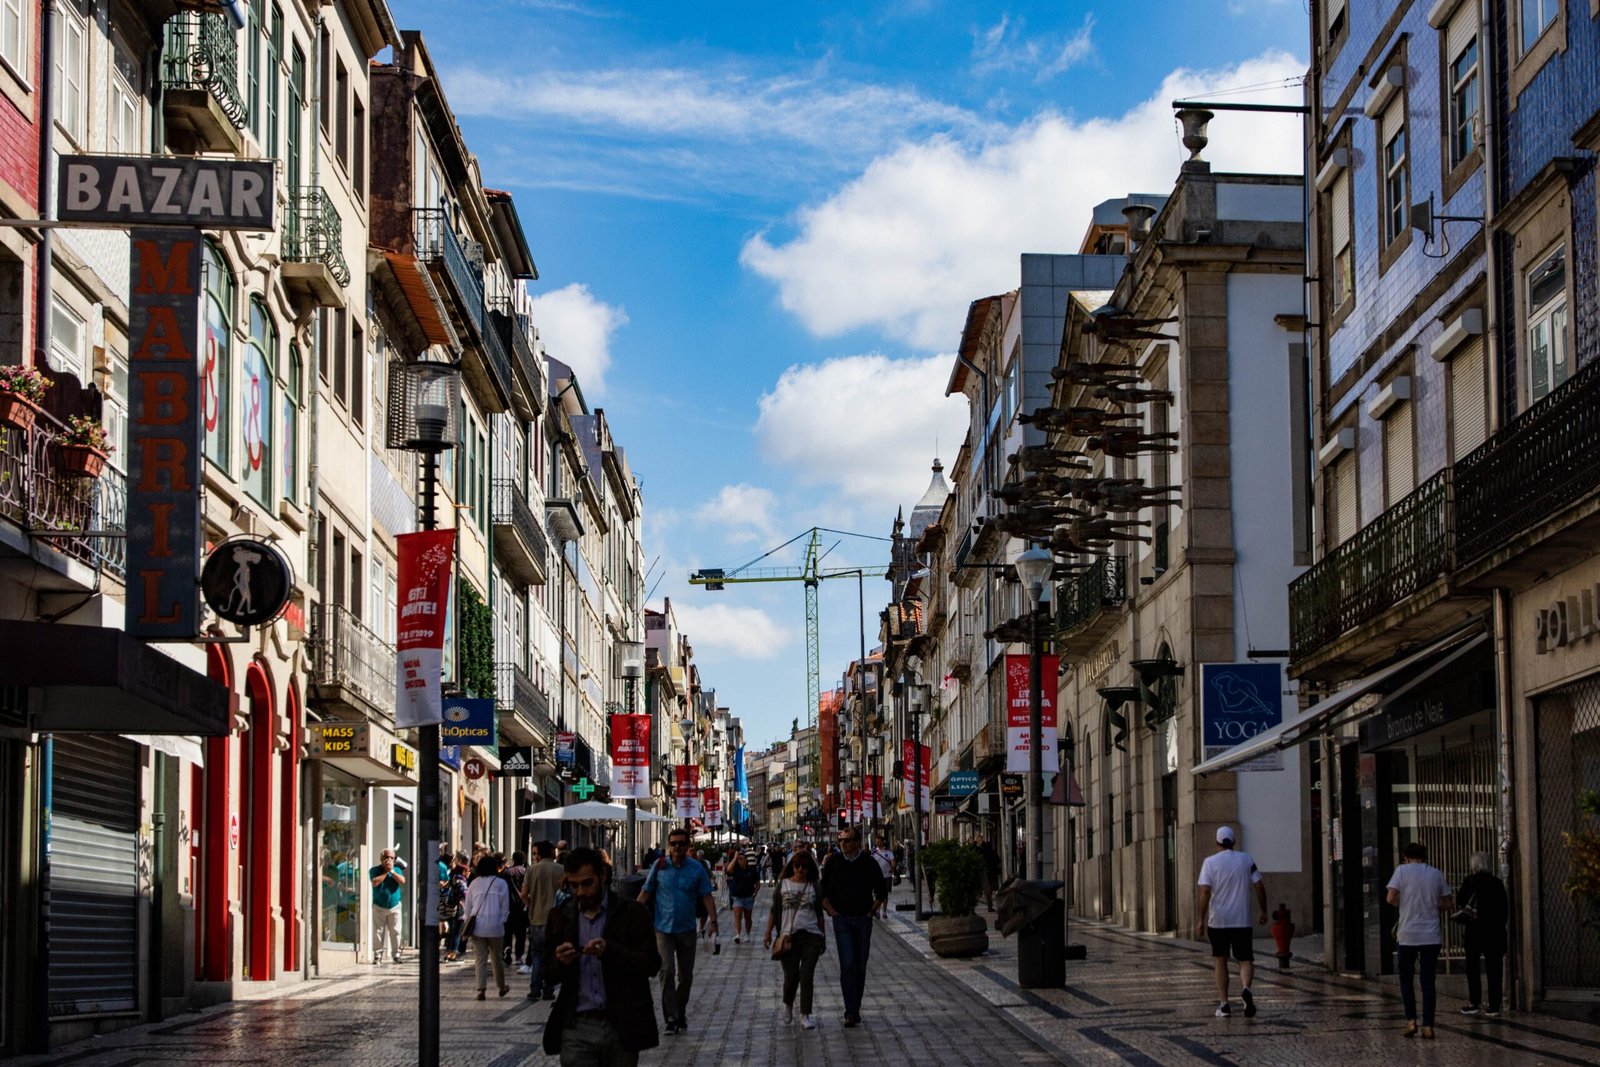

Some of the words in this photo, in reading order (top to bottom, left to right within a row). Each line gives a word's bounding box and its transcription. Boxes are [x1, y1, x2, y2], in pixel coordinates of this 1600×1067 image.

[66, 164, 266, 219] BAZAR
[133, 239, 196, 625] MABRIL
[322, 727, 354, 738] MASS
[441, 726, 489, 737] ltiOpticas
[1213, 720, 1271, 740] YOGA
[324, 741, 351, 751] KIDS
[503, 762, 530, 770] adidas
